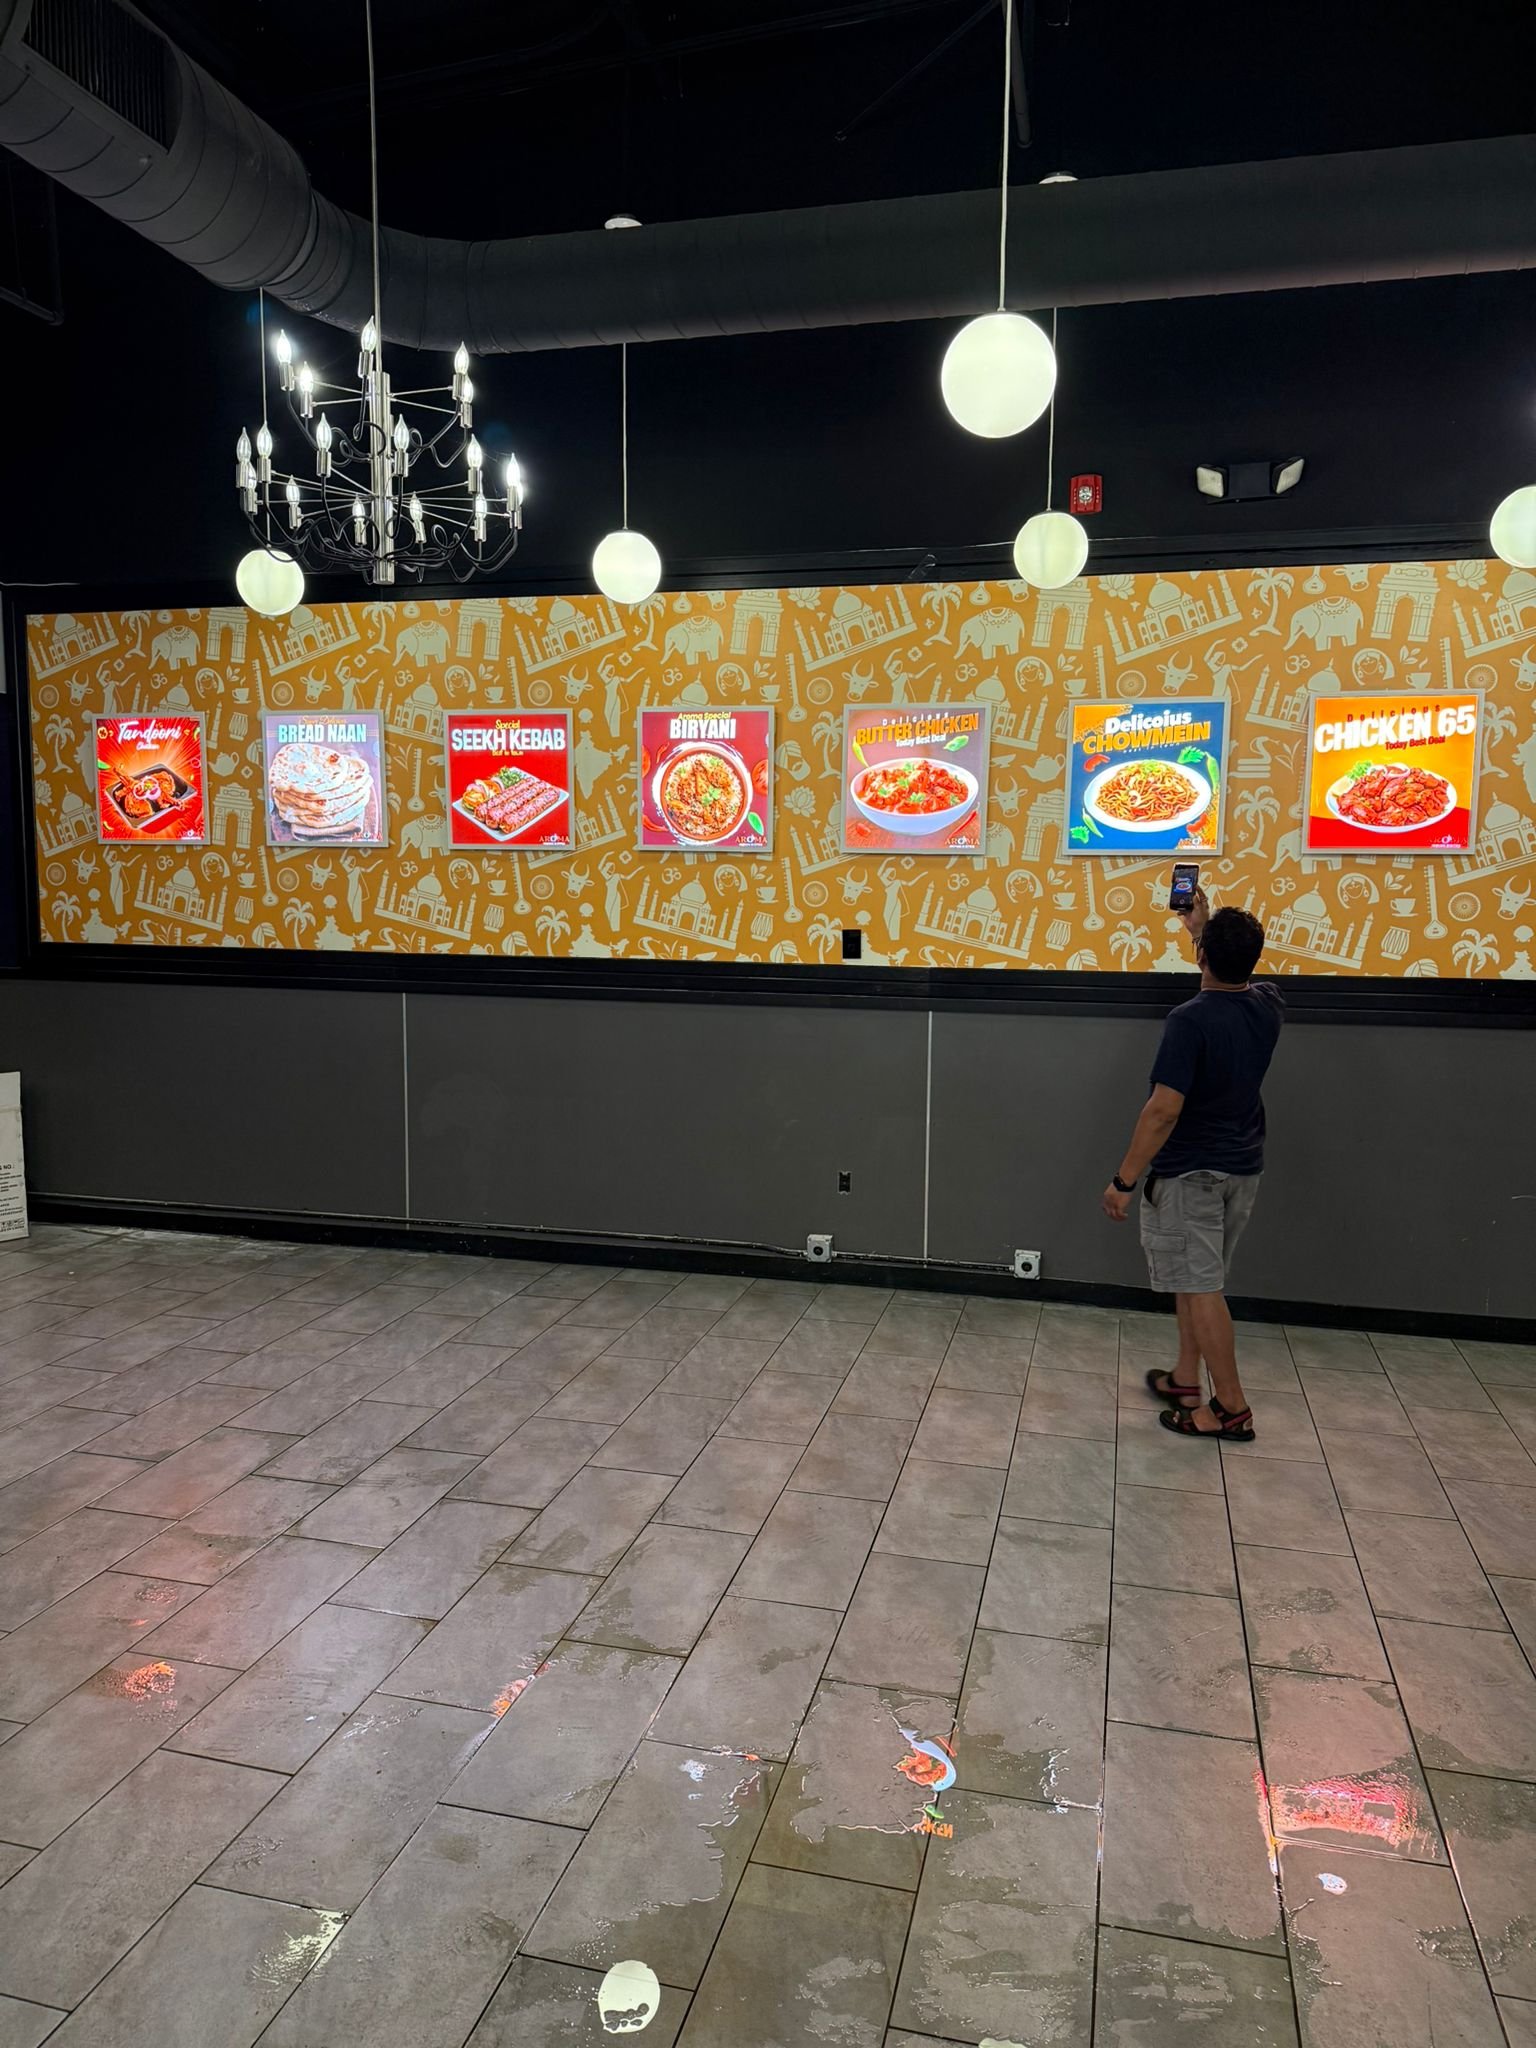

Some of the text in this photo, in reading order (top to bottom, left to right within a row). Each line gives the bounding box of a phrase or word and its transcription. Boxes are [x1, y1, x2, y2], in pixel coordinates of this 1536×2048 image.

[1105, 710, 1192, 734] Delicoius
[1347, 704, 1441, 722] Delicious
[118, 719, 182, 745] Tandoori
[278, 723, 367, 743] BREAD NAAN
[452, 728, 566, 751] SEEKH KEBAB
[670, 719, 737, 739] BIRYANI
[856, 712, 979, 746] BUTTER CHICKEN
[1083, 721, 1212, 754] CHOWMEIN
[1314, 704, 1477, 753] CHICKEN 65
[1385, 735, 1446, 751] Today Best Deal
